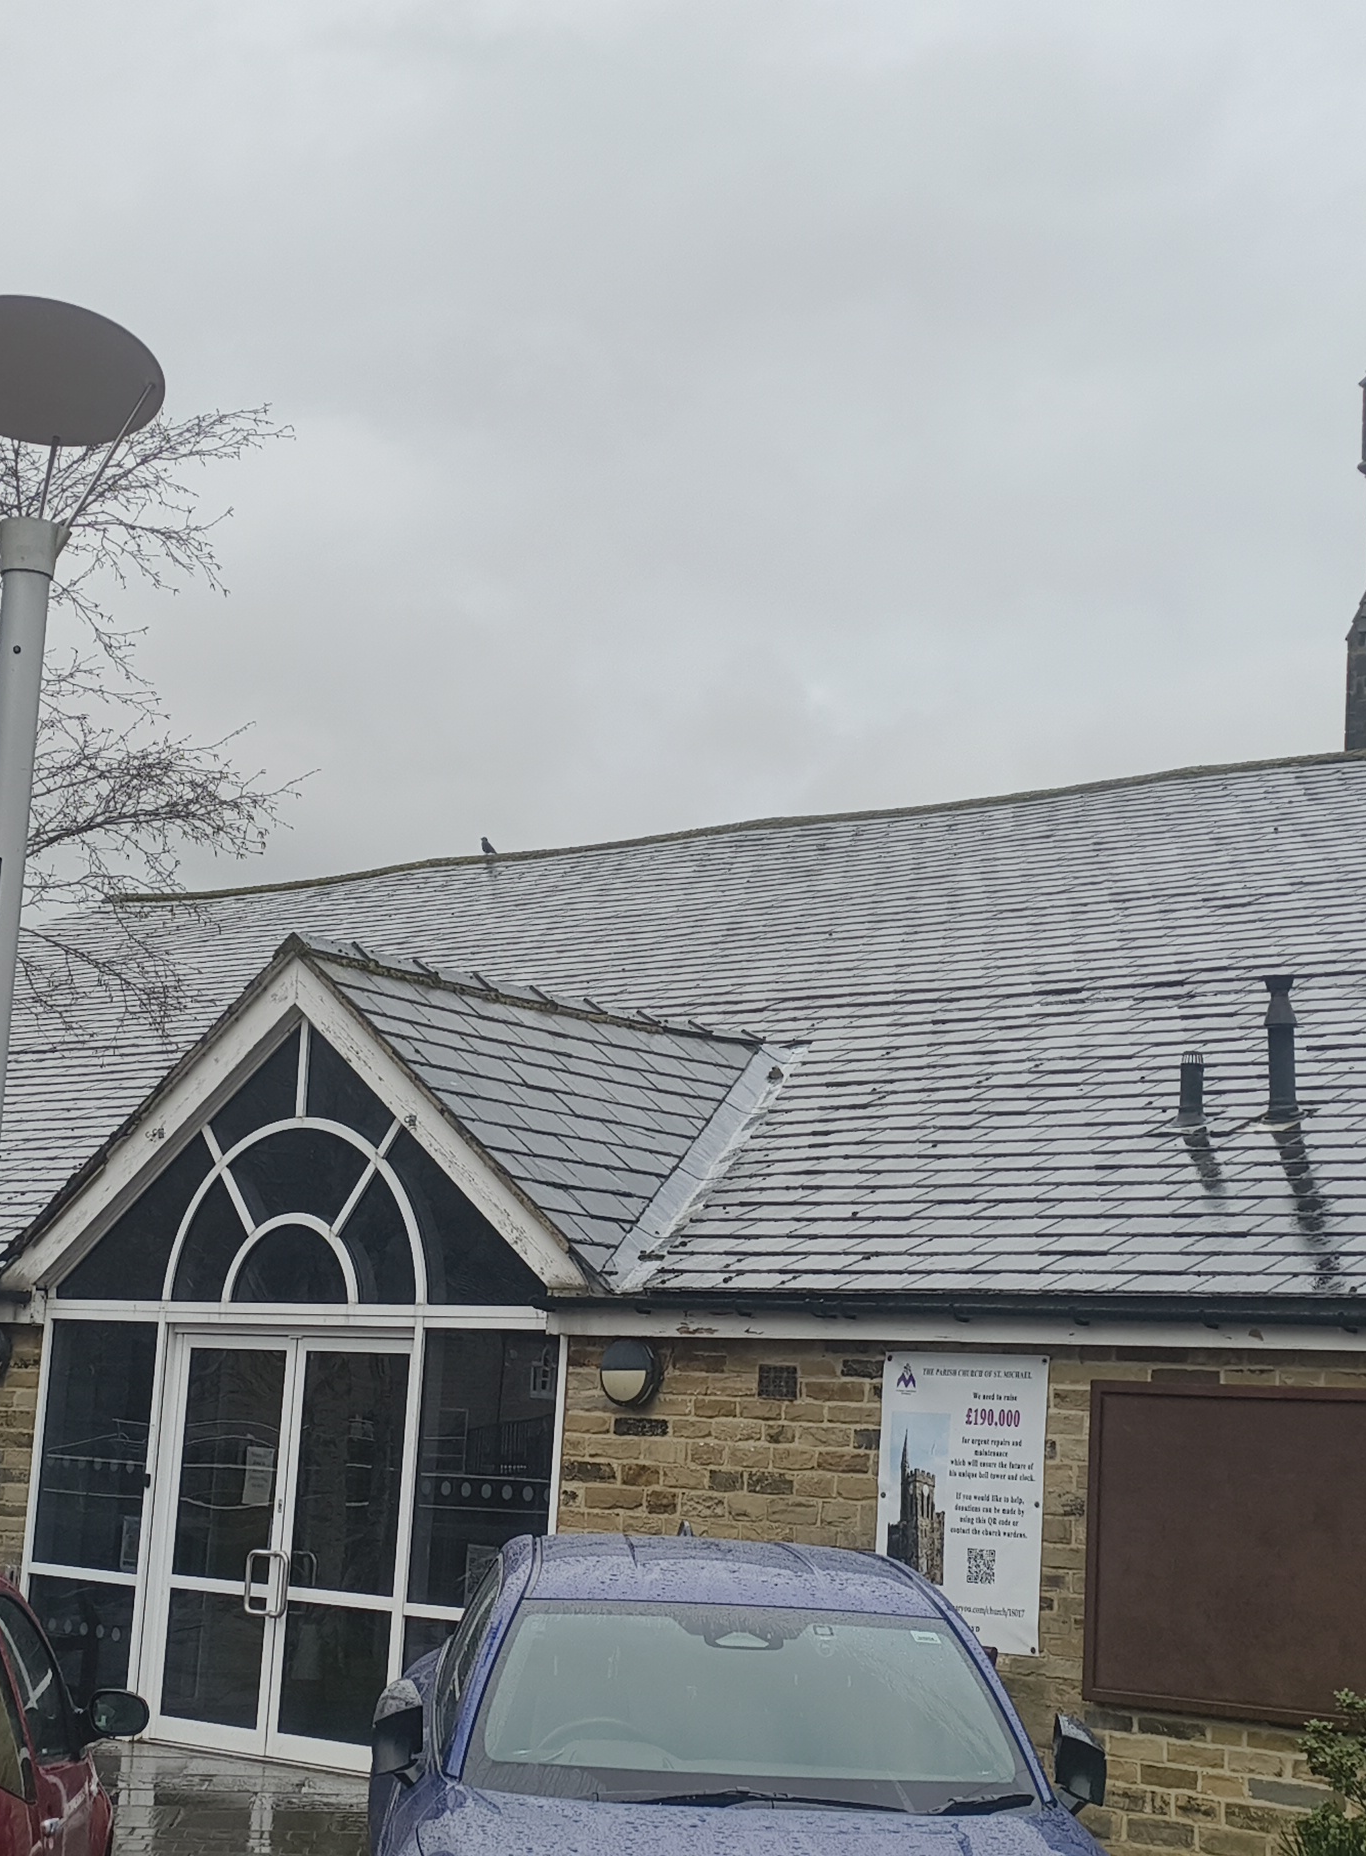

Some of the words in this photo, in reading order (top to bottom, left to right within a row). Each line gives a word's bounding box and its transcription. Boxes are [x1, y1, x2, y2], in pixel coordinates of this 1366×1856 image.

[923, 1368, 934, 1376] THE
[936, 1368, 957, 1376] PARISH
[958, 1369, 983, 1378] CHURCH
[1002, 1371, 1032, 1379] MICHAEL
[973, 1392, 981, 1400] We
[983, 1393, 994, 1401] need
[1004, 1394, 1017, 1402] raise
[961, 1436, 970, 1444] for
[971, 1438, 989, 1446] urgent
[991, 1438, 1010, 1447] repairs
[974, 1449, 1008, 1457] maintenance
[968, 1459, 978, 1467] will
[1009, 1462, 1026, 1470] future
[958, 1470, 977, 1479] unique
[979, 1471, 988, 1479] bell
[963, 1494, 972, 1502] you
[974, 1494, 990, 1502] would
[955, 1504, 980, 1512] donations
[1017, 1508, 1024, 1517] by
[959, 1516, 974, 1525] using
[975, 1516, 986, 1524] this
[988, 1517, 997, 1526] QR
[998, 1518, 1011, 1526] code
[982, 1528, 1001, 1537] church
